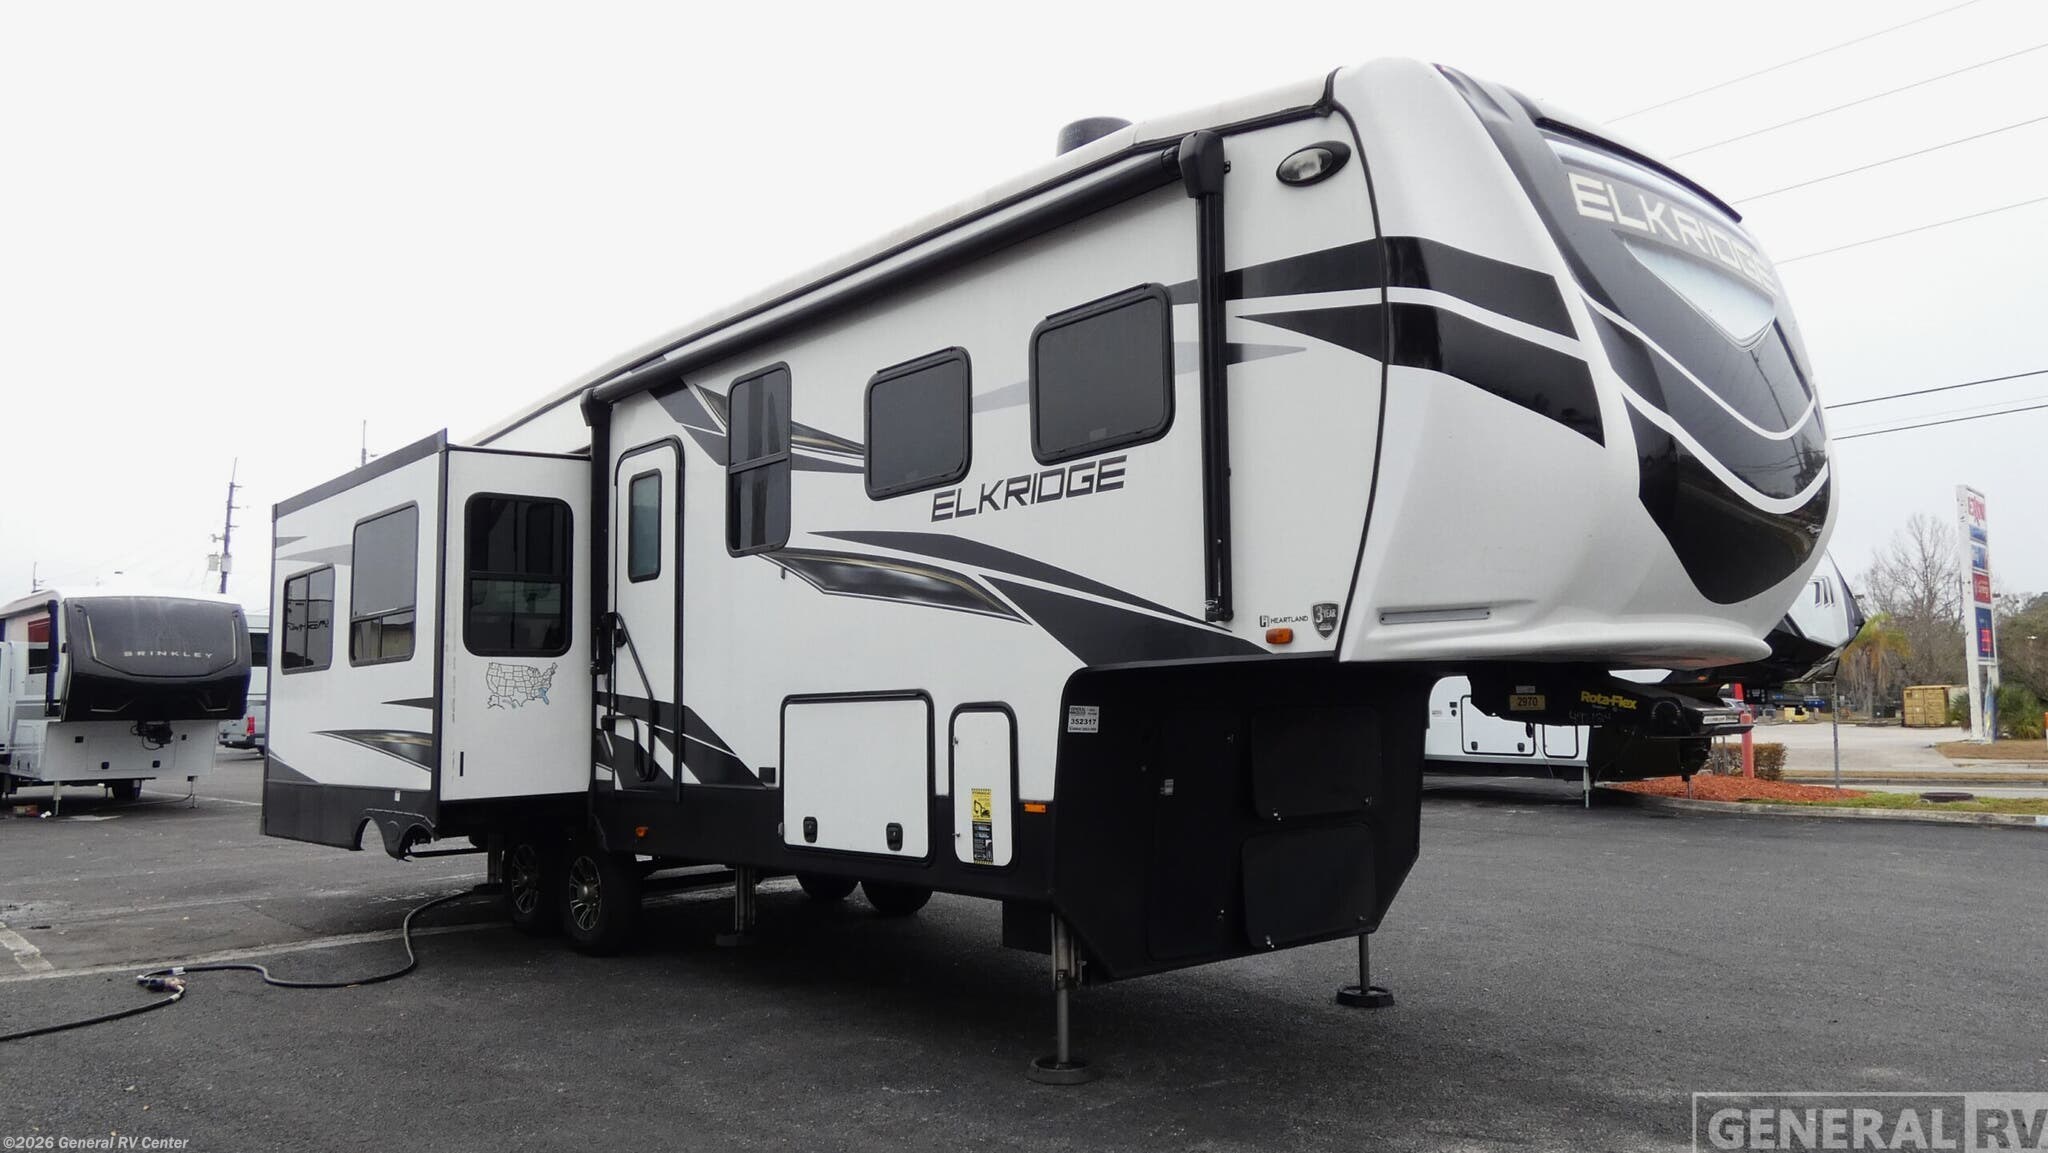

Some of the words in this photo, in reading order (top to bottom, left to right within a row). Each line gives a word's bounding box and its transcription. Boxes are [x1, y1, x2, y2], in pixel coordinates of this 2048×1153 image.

[1568, 172, 1778, 295] ELKRIDGE
[931, 455, 1127, 522] ELKRIDGE
[1323, 608, 1337, 618] YEAR
[1270, 615, 1308, 624] HEARTLAND
[123, 650, 213, 659] BRINKLEY
[1517, 697, 1538, 707] 2970
